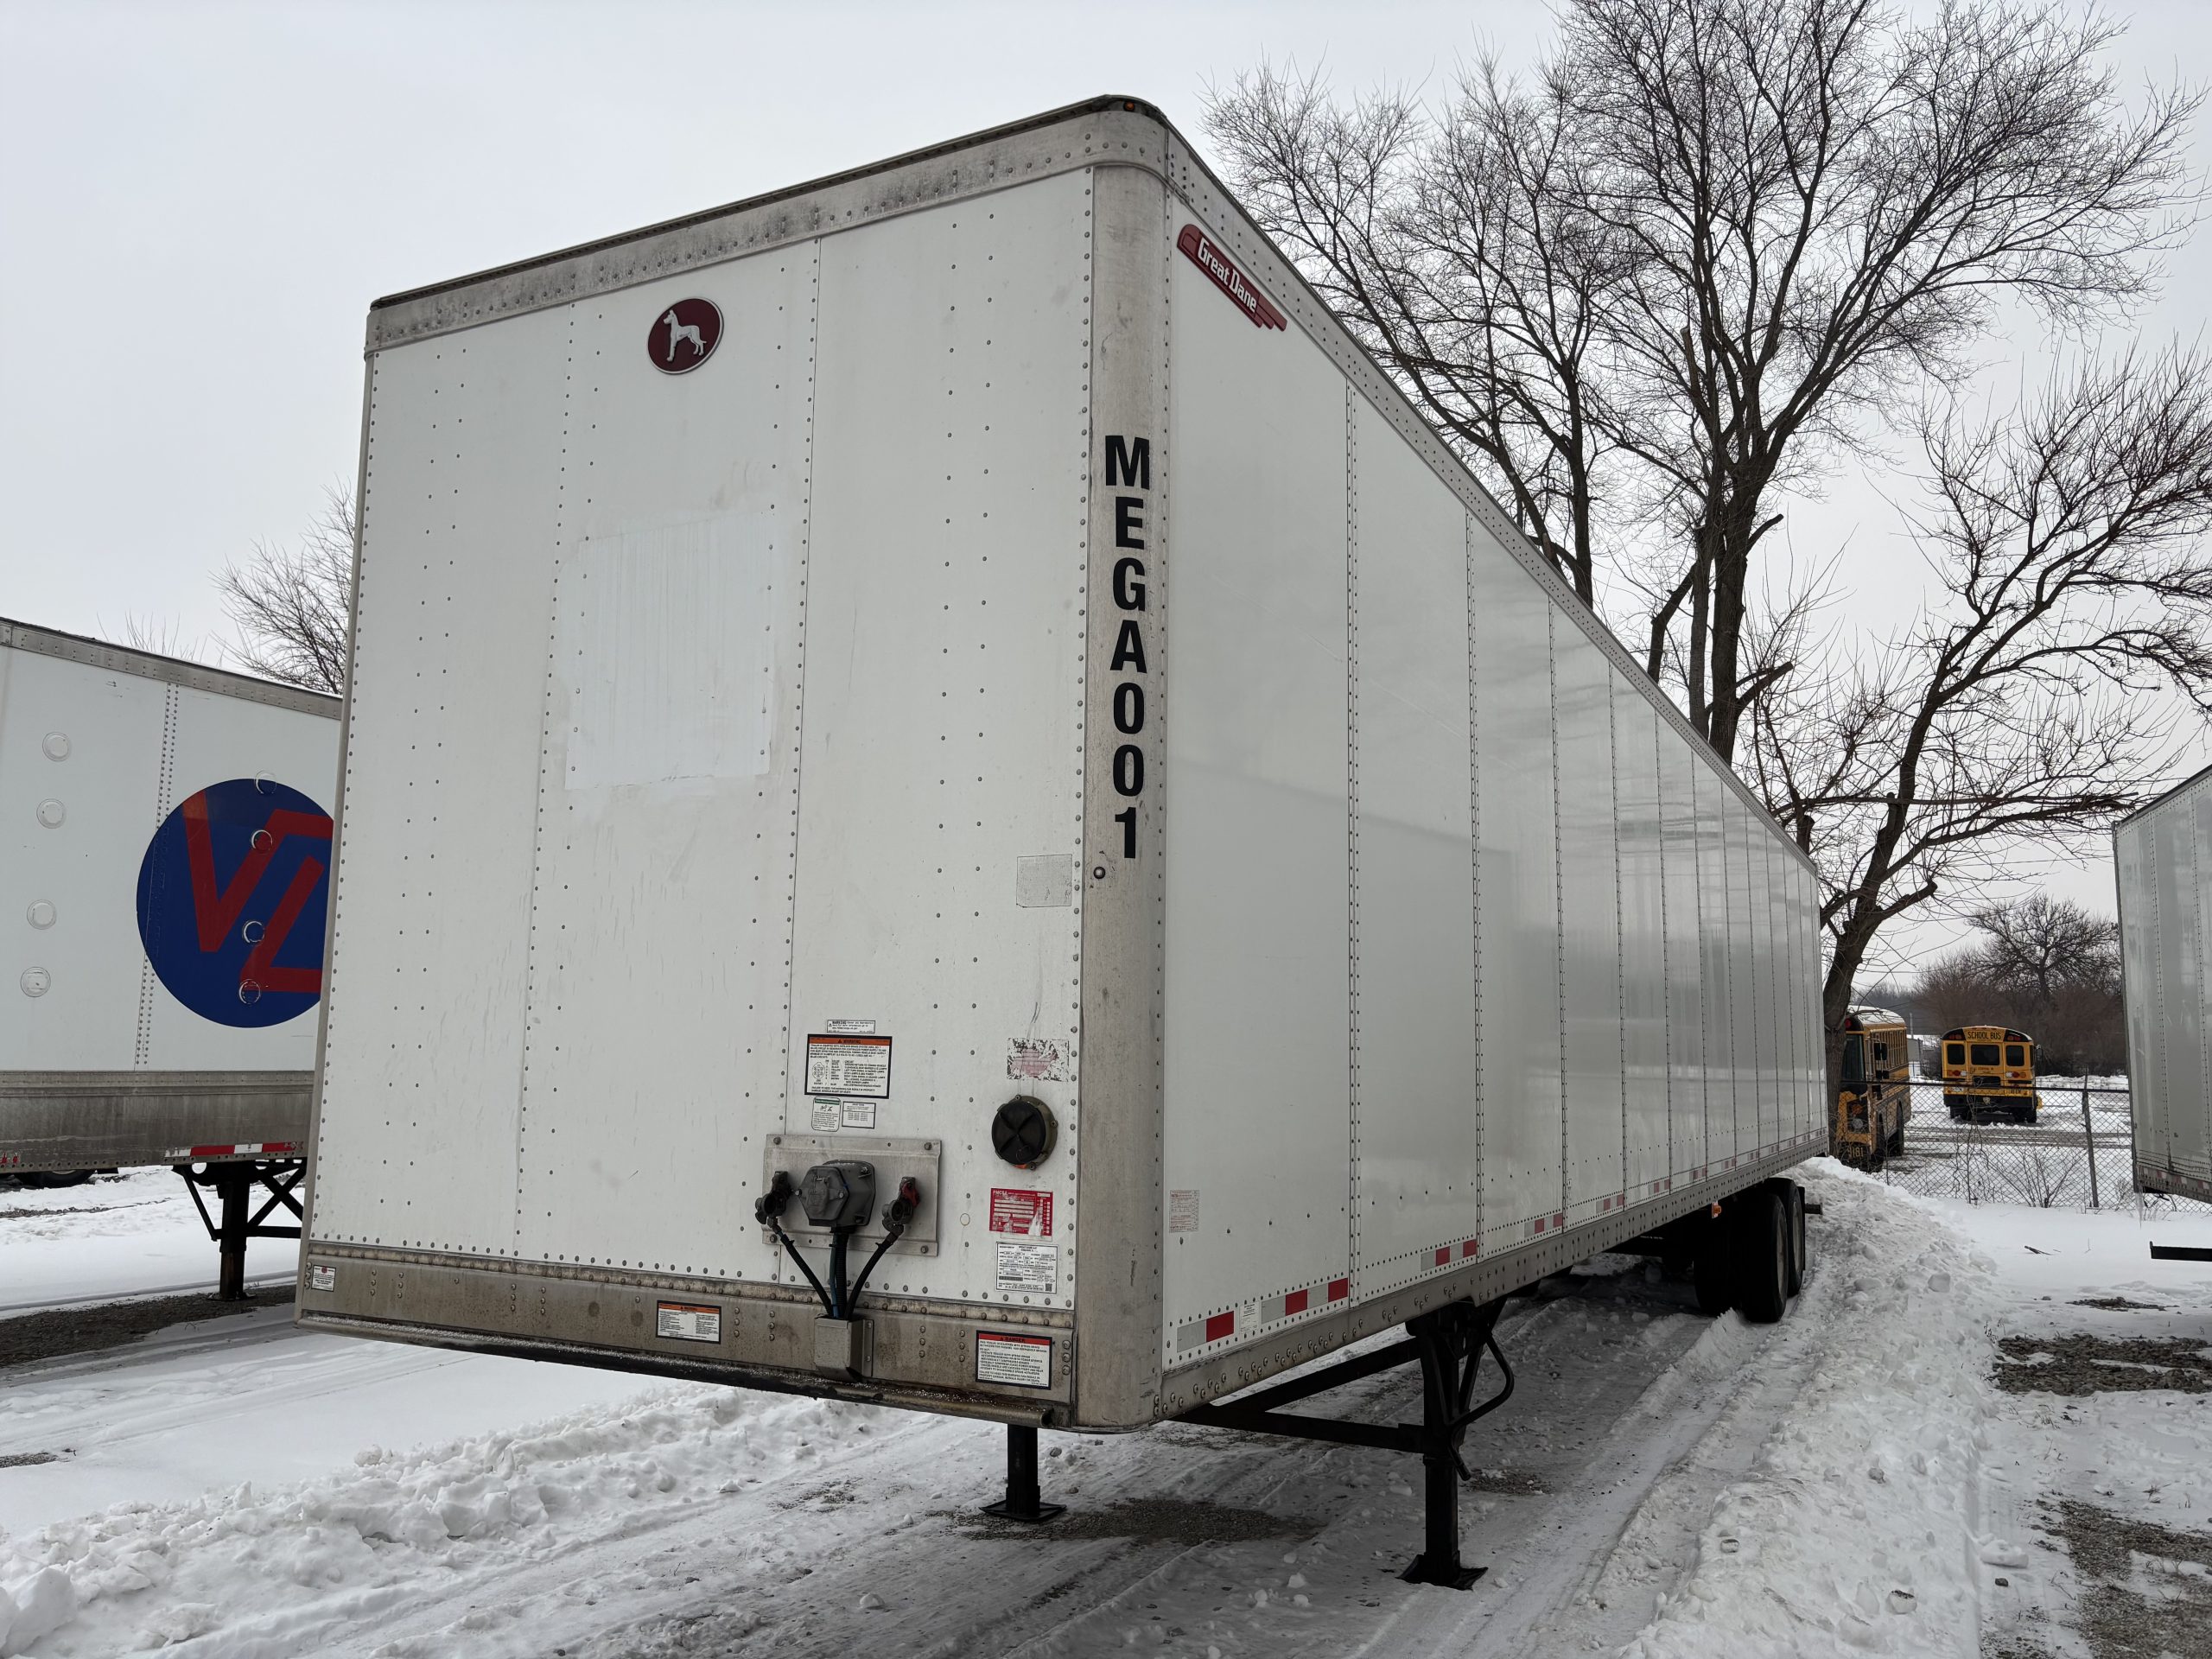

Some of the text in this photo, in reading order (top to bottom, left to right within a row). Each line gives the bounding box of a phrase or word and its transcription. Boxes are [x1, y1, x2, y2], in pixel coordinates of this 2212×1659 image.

[1197, 237, 1258, 314] Great Dane
[1104, 435, 1151, 860] MEGA001
[1967, 1031, 1989, 1039] SCHOOL
